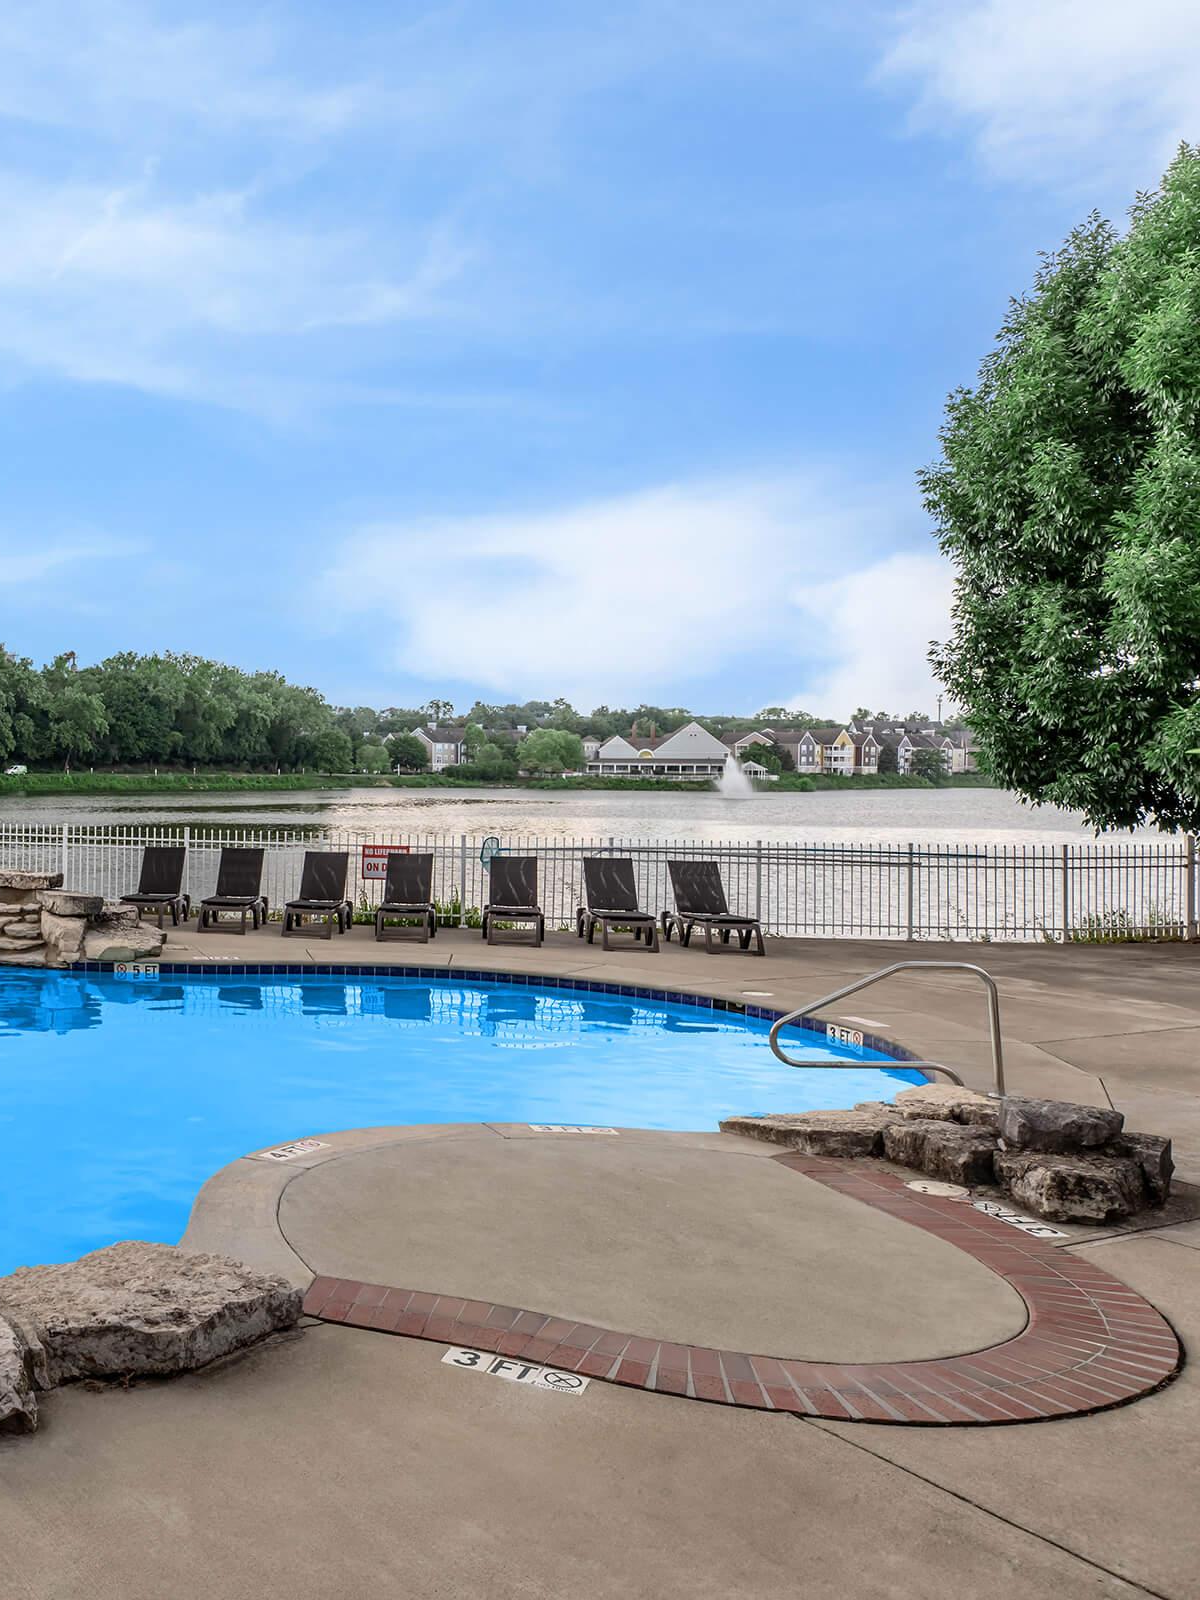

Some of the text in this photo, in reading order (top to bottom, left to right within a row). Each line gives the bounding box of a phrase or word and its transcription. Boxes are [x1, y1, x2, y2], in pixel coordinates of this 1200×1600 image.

[366, 862, 379, 872] ON
[280, 1145, 307, 1155] FT
[994, 1212, 1059, 1237] 3 FT
[452, 1350, 539, 1380] 3 FT
